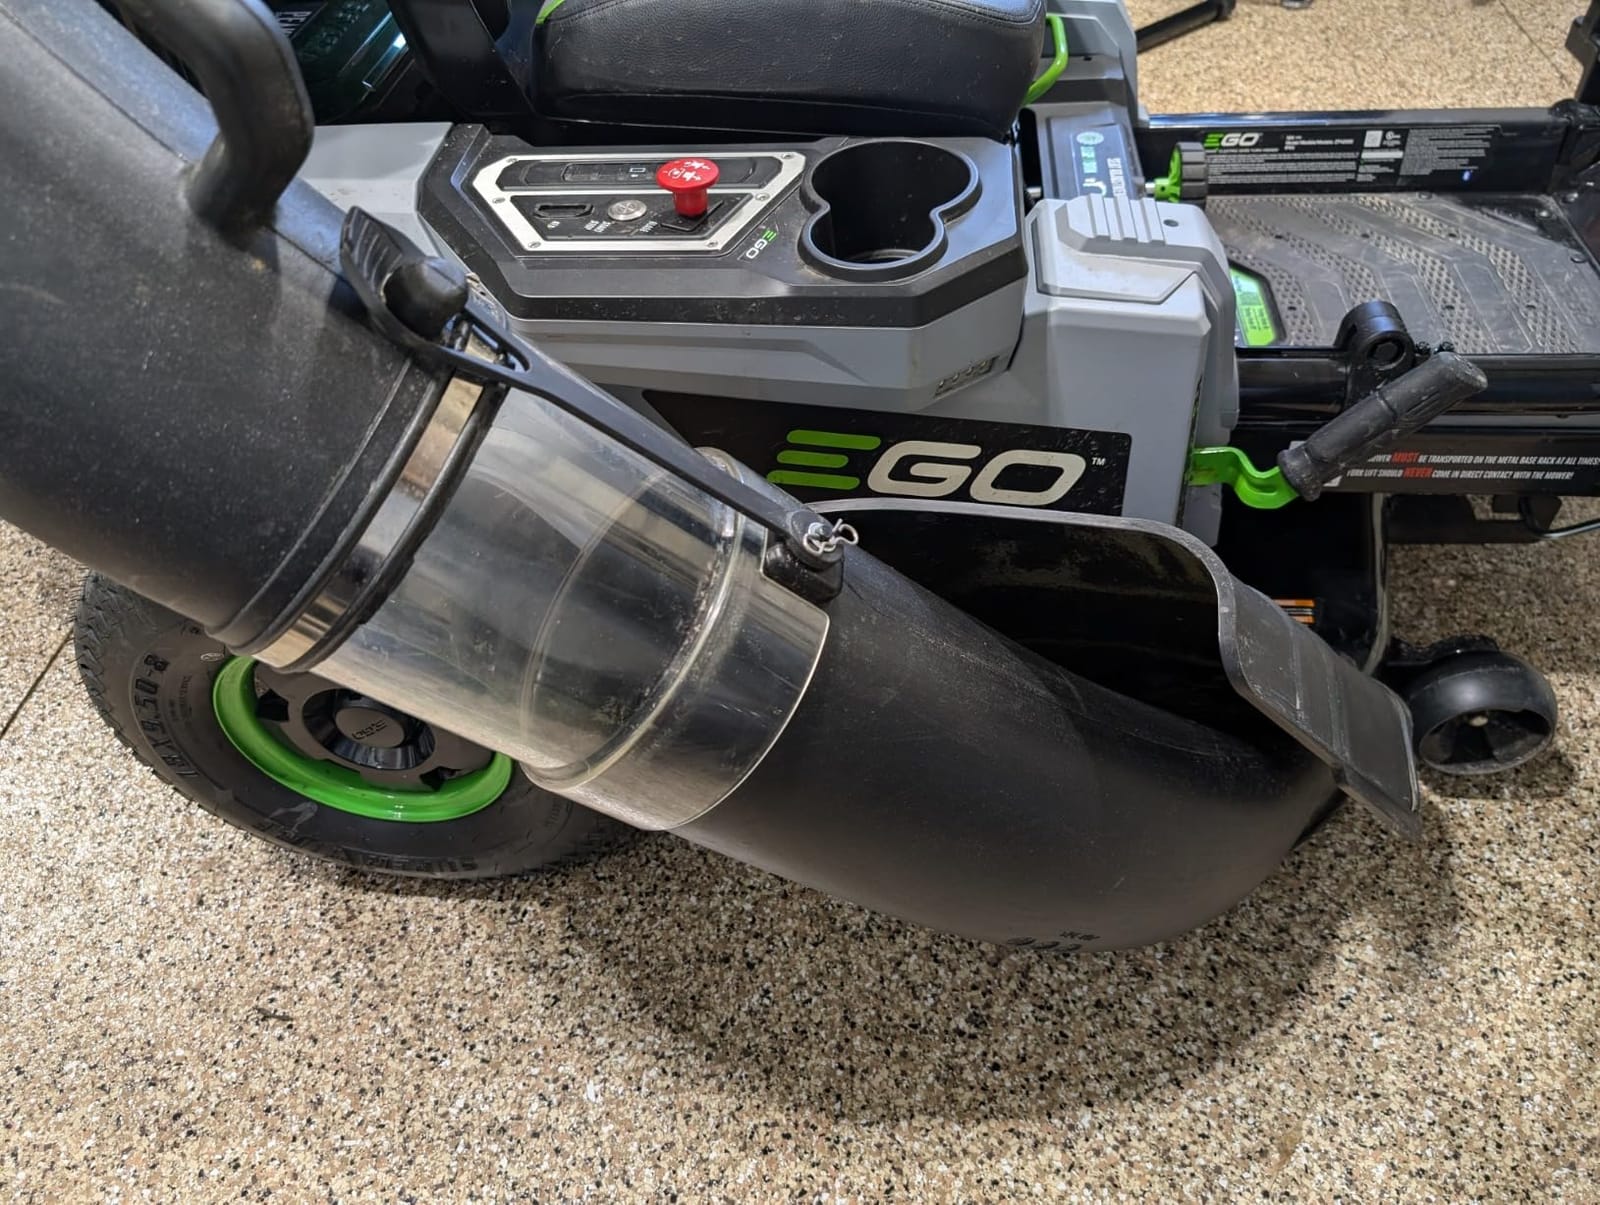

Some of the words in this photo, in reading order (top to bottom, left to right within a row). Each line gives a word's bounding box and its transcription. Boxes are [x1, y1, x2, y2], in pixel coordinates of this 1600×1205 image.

[1203, 132, 1261, 147] EGO
[745, 230, 777, 259] EGO
[1391, 451, 1420, 463] MUST
[1418, 454, 1429, 464] BE
[1427, 455, 1474, 464] TRANSPORTED
[1472, 455, 1485, 464] ON
[1484, 455, 1498, 464] THE
[1496, 455, 1520, 464] METAL
[1519, 456, 1538, 465] BASE
[1536, 456, 1557, 465] RACK
[1554, 456, 1566, 465] AT
[1563, 457, 1577, 465] ALL
[766, 429, 1087, 506] EGO
[1363, 469, 1379, 478] LIFT
[1377, 469, 1404, 478] SHOULD
[1402, 466, 1434, 479] NEVER
[1432, 470, 1452, 479] COME
[1450, 470, 1461, 479] IN
[1459, 470, 1485, 479] DIRECT
[1483, 470, 1514, 479] CONTACT
[1512, 471, 1532, 480] WITH
[1530, 471, 1546, 480] THE
